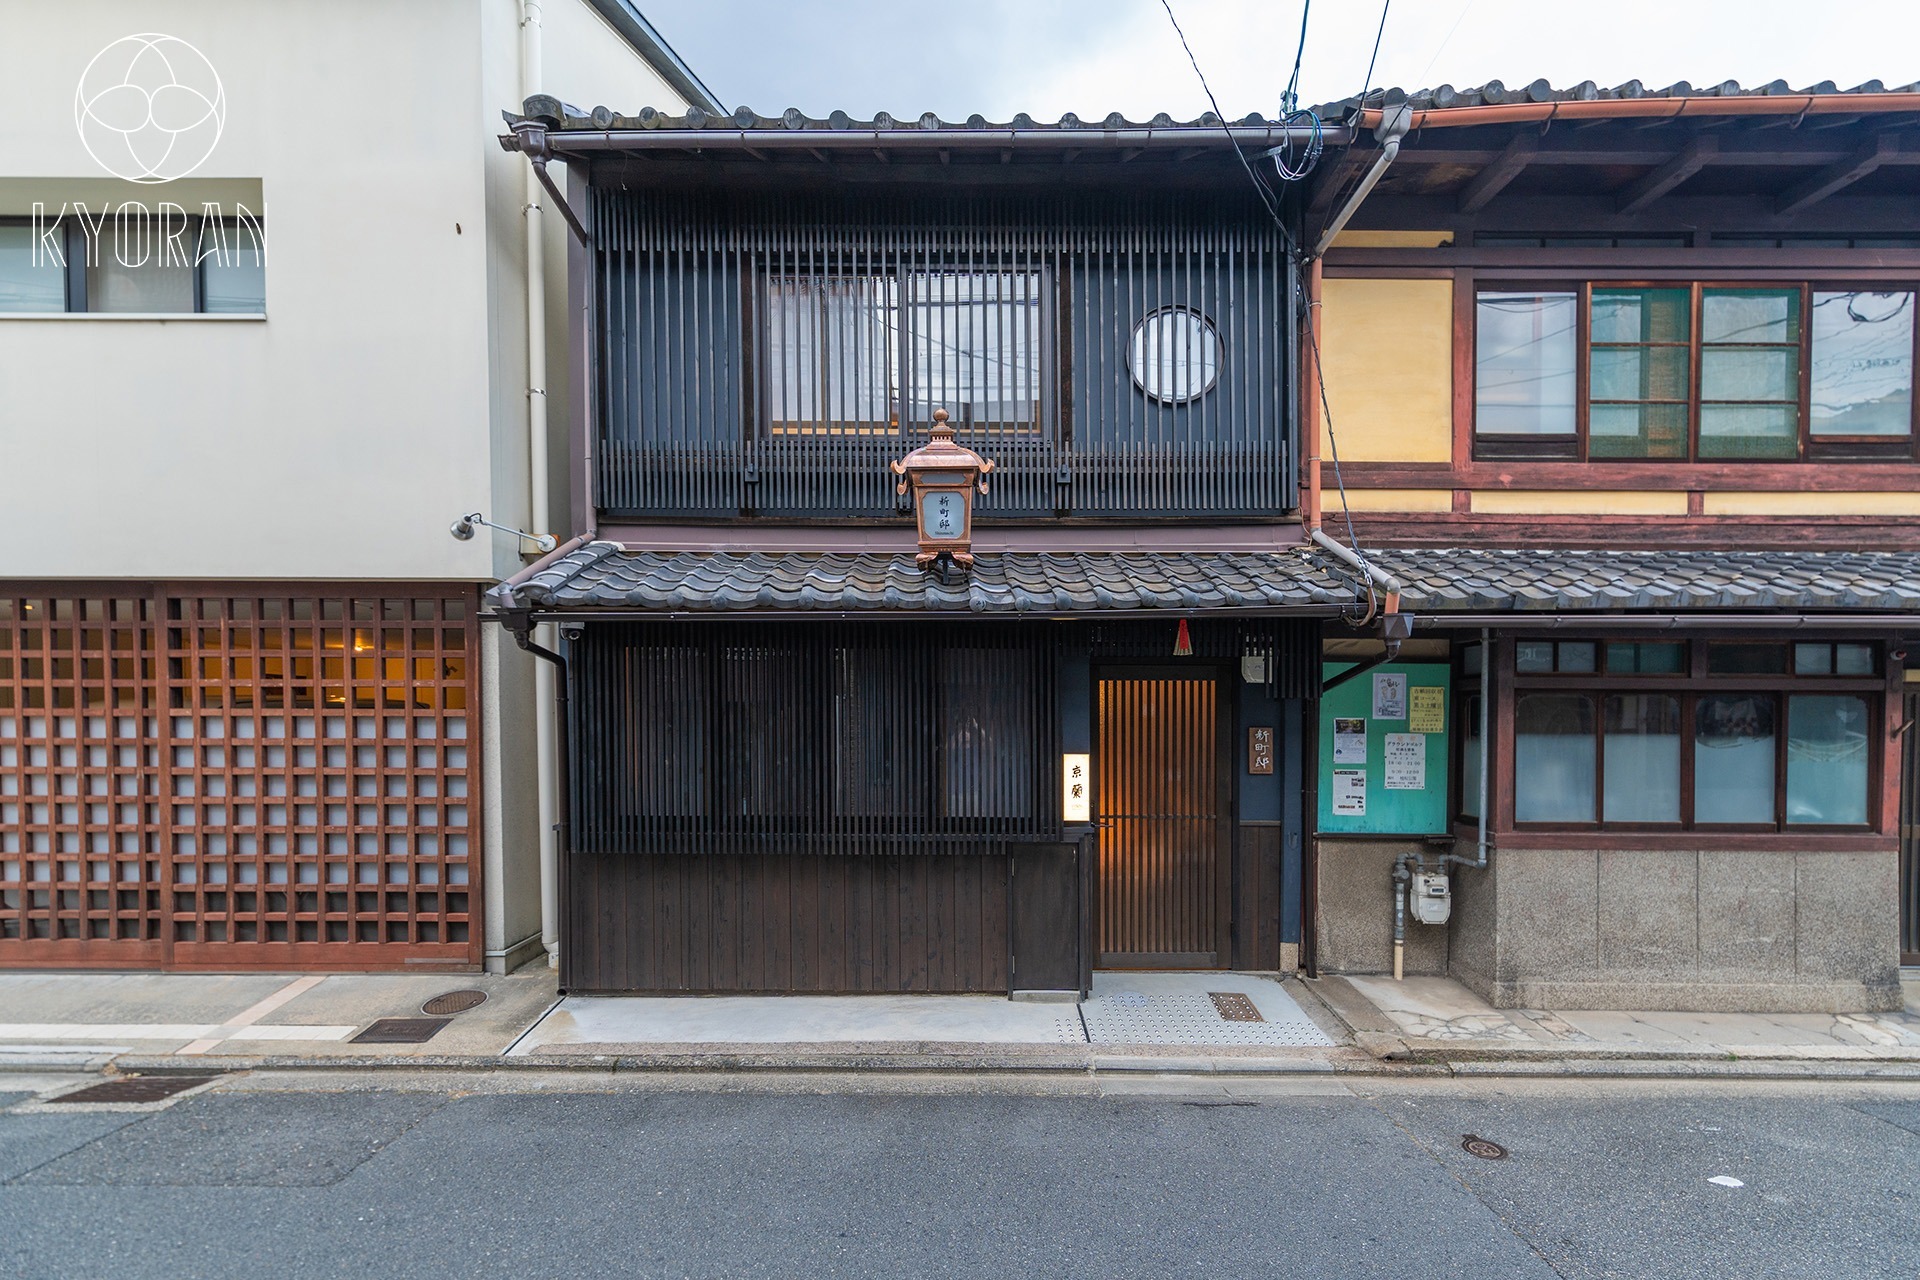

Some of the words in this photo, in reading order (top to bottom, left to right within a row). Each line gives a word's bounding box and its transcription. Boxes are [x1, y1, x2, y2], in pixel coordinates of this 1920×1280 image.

[939, 496, 950, 530] 新町邸
[1255, 729, 1269, 769] 新町邸
